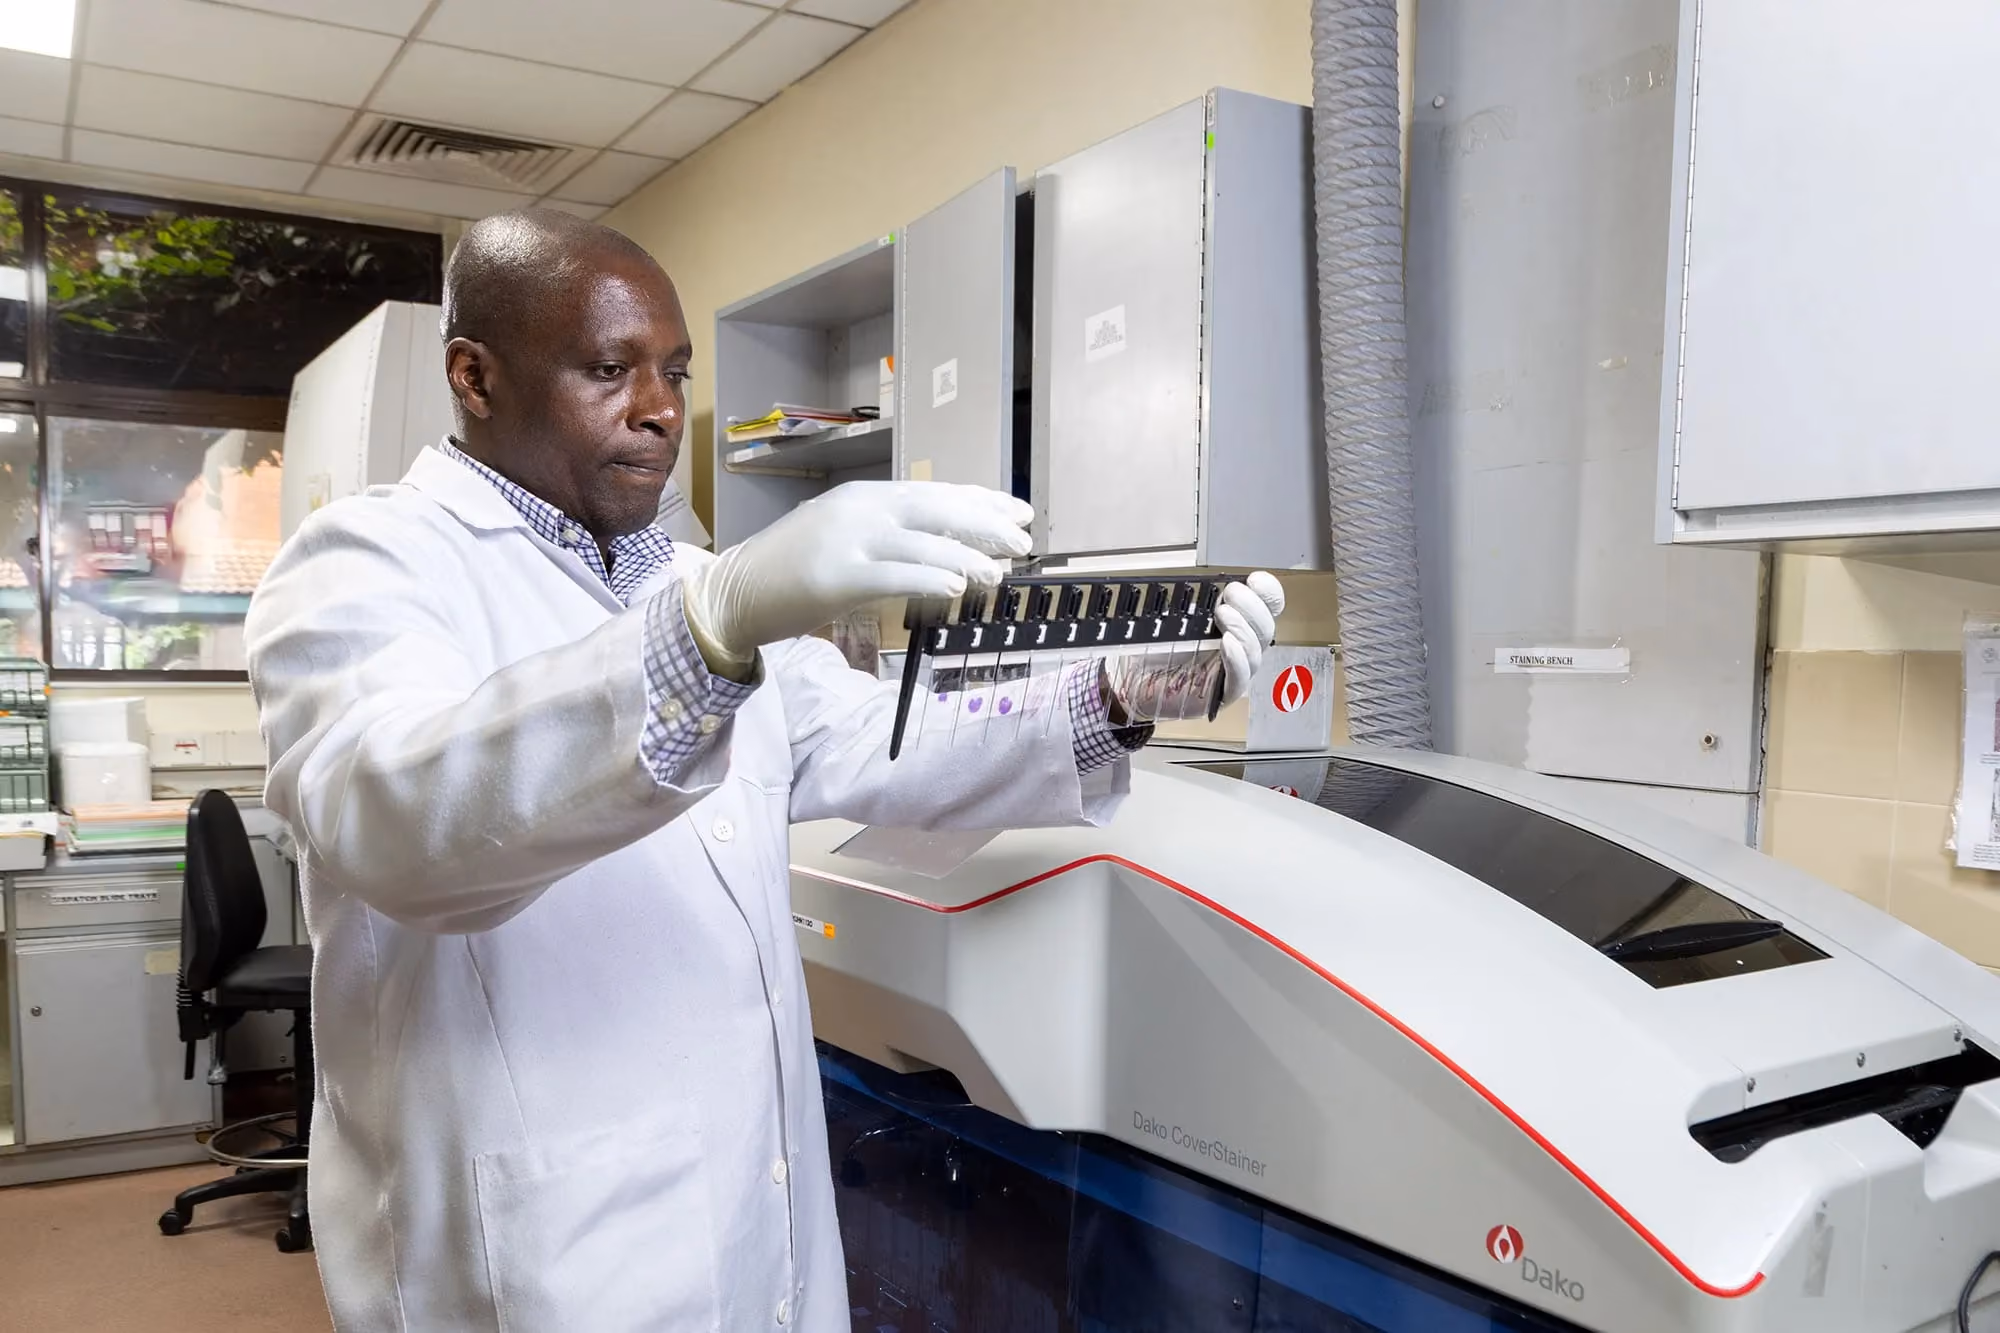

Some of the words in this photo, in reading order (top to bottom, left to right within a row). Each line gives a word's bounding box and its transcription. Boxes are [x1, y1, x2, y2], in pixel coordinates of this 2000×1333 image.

[1509, 655, 1545, 665] STAINING
[1546, 656, 1574, 665] BENCH
[1133, 1110, 1168, 1140] Dako
[1172, 1126, 1266, 1177] CoverStainer
[1521, 1256, 1585, 1302] Dako
